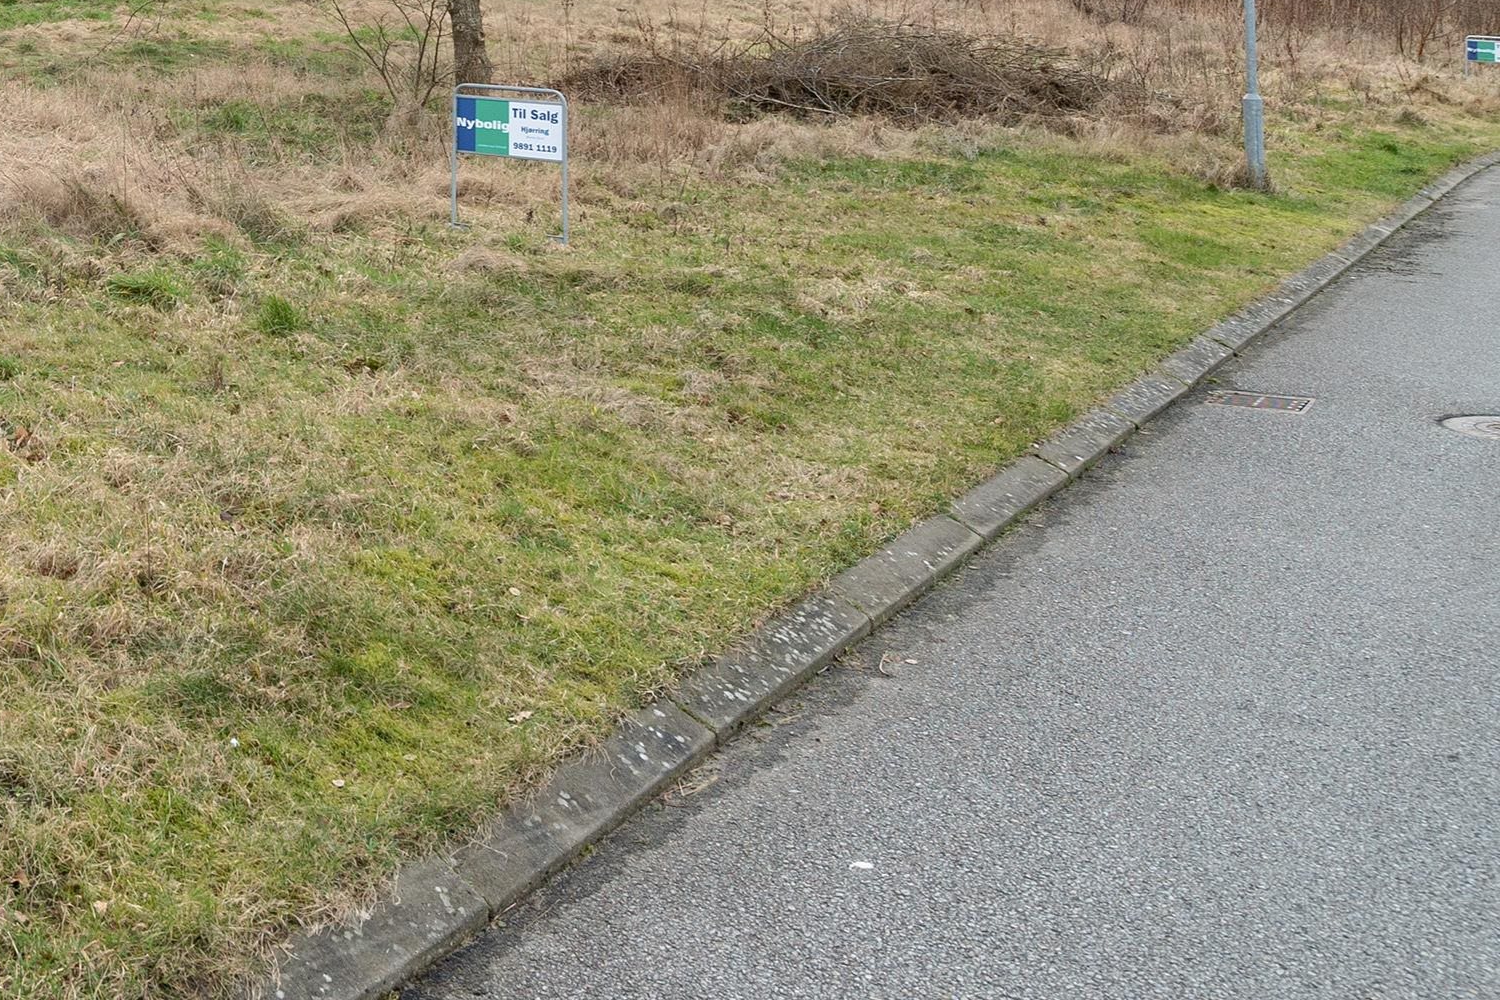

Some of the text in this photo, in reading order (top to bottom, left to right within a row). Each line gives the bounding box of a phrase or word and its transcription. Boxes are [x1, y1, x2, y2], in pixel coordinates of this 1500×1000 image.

[512, 108, 558, 124] Til Salg
[456, 117, 509, 134] Nybolig
[521, 126, 550, 136] Hjørring
[513, 142, 557, 153] 9891 1119
